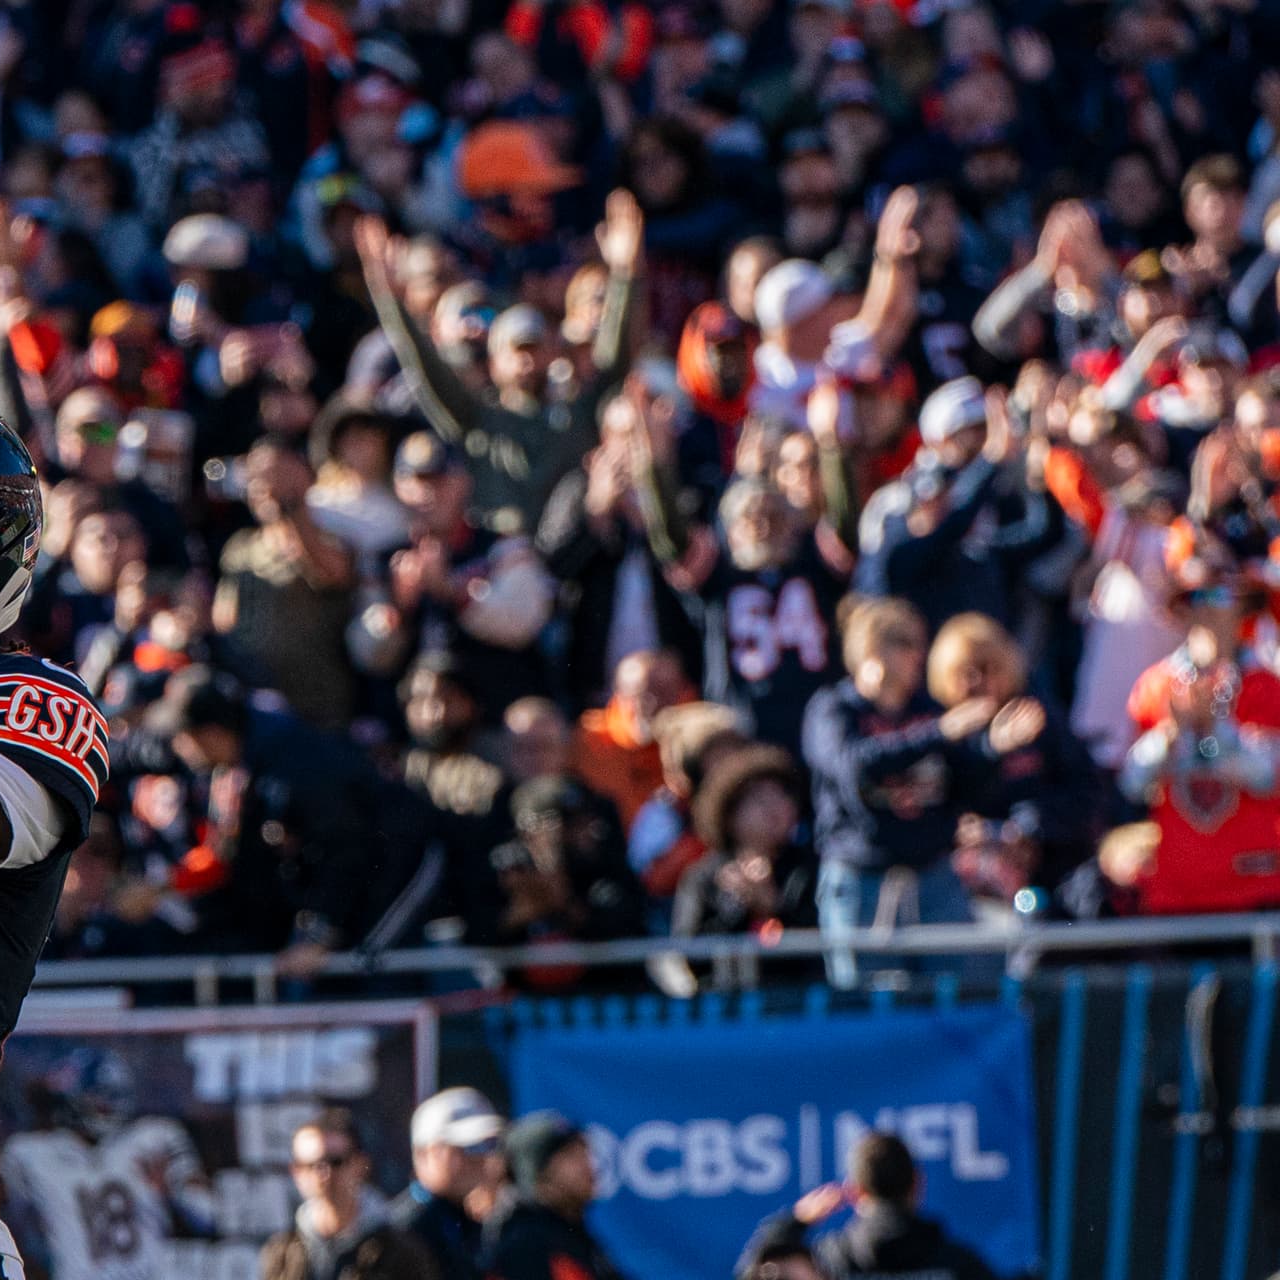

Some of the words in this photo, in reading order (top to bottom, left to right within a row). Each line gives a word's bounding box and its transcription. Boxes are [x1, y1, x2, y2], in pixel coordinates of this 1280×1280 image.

[727, 577, 828, 681] 54
[6, 684, 97, 760] GSH
[621, 1113, 792, 1201] CBS
